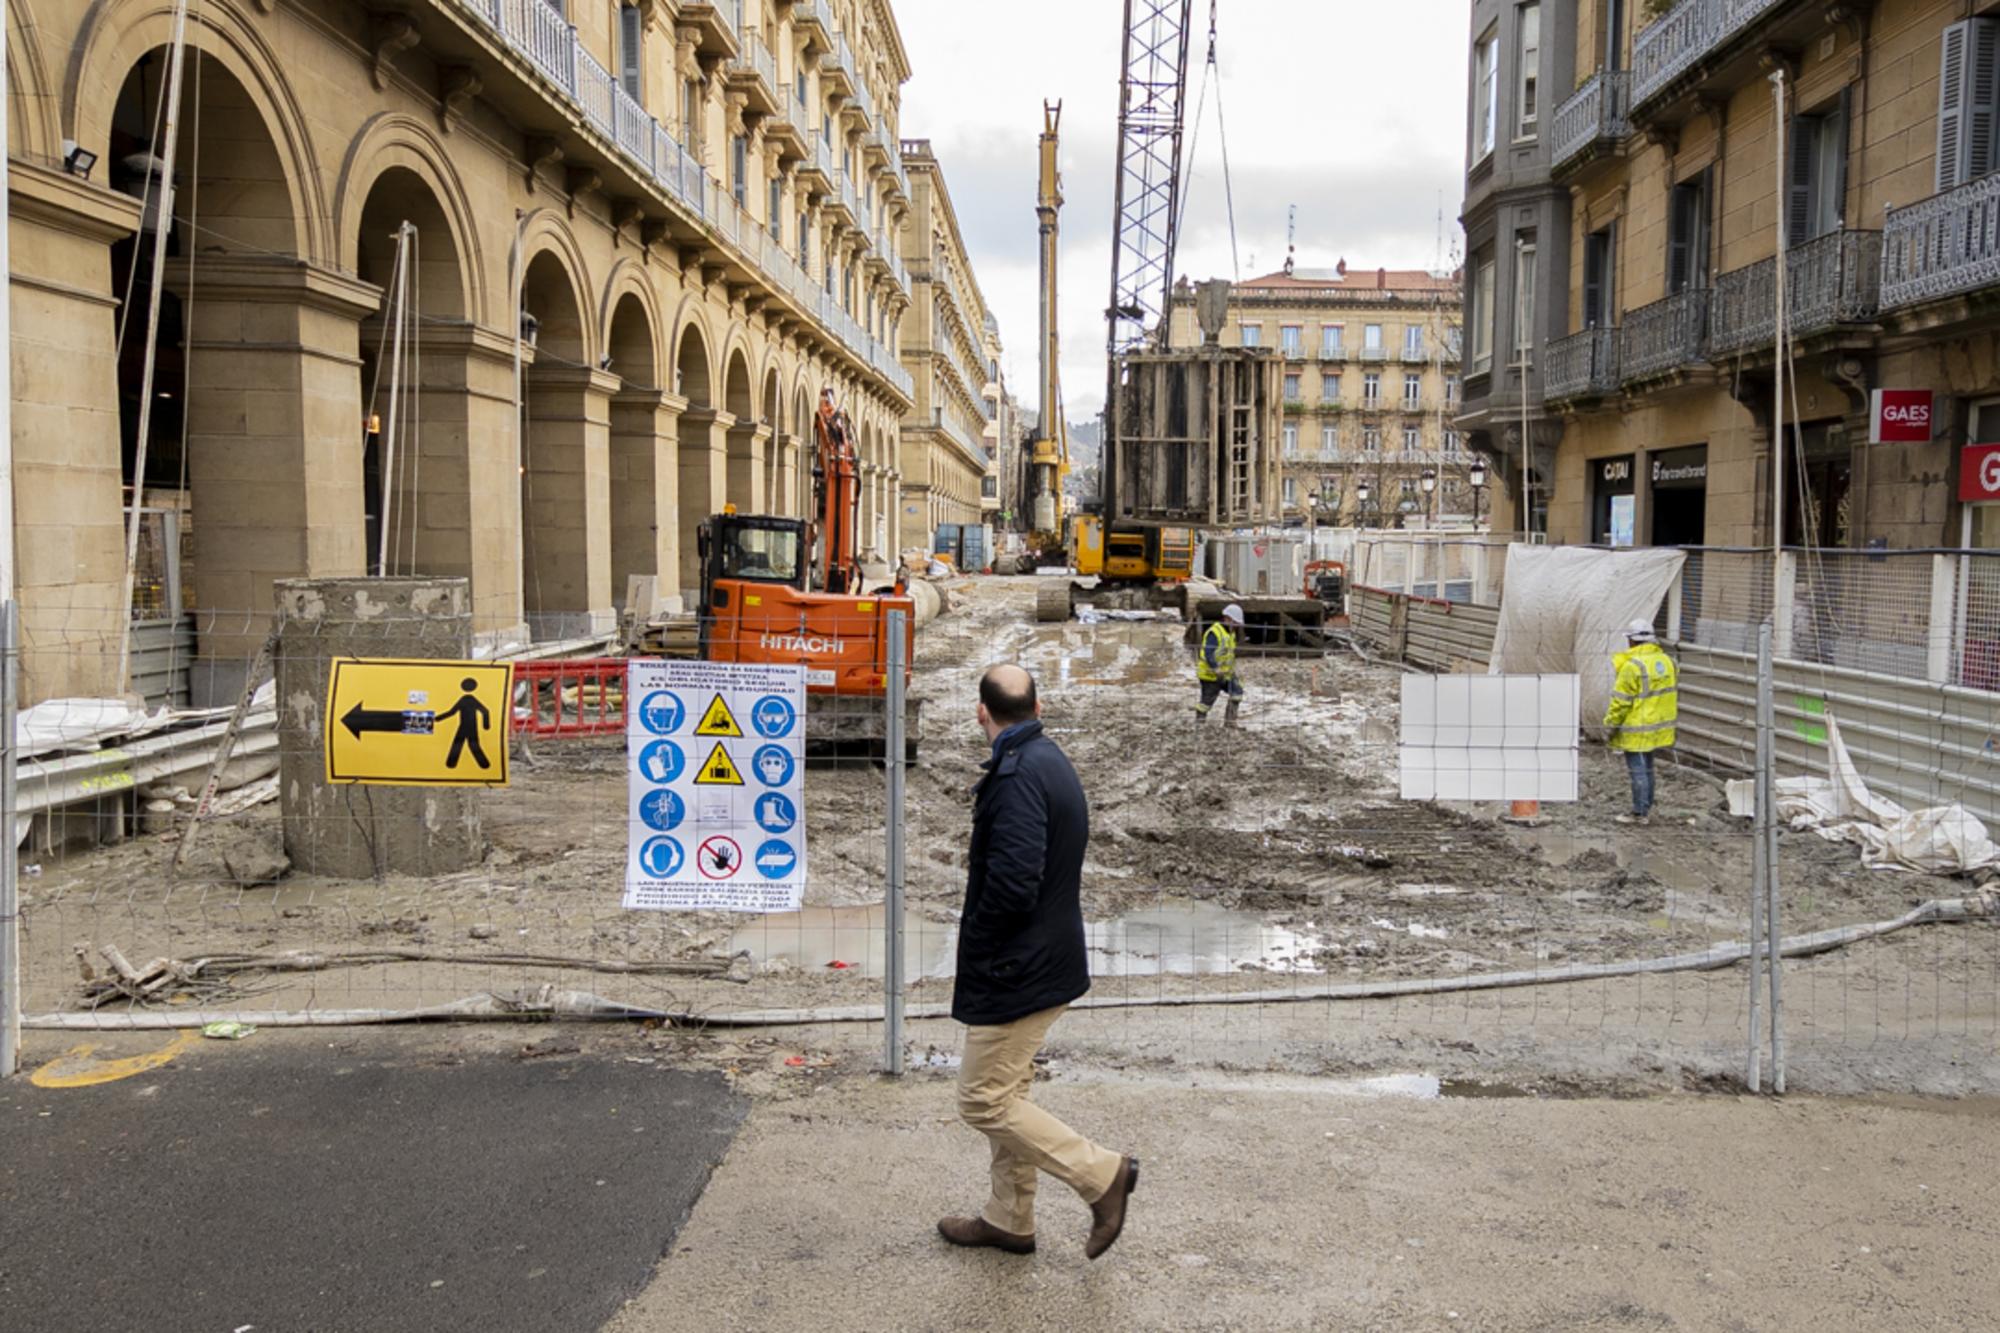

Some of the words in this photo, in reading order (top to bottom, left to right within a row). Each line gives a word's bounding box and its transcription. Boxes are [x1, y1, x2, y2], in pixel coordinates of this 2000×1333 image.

[1883, 405, 1929, 421] GAES
[760, 634, 844, 654] HITACHI
[668, 676, 741, 684] OBLIGATORIO
